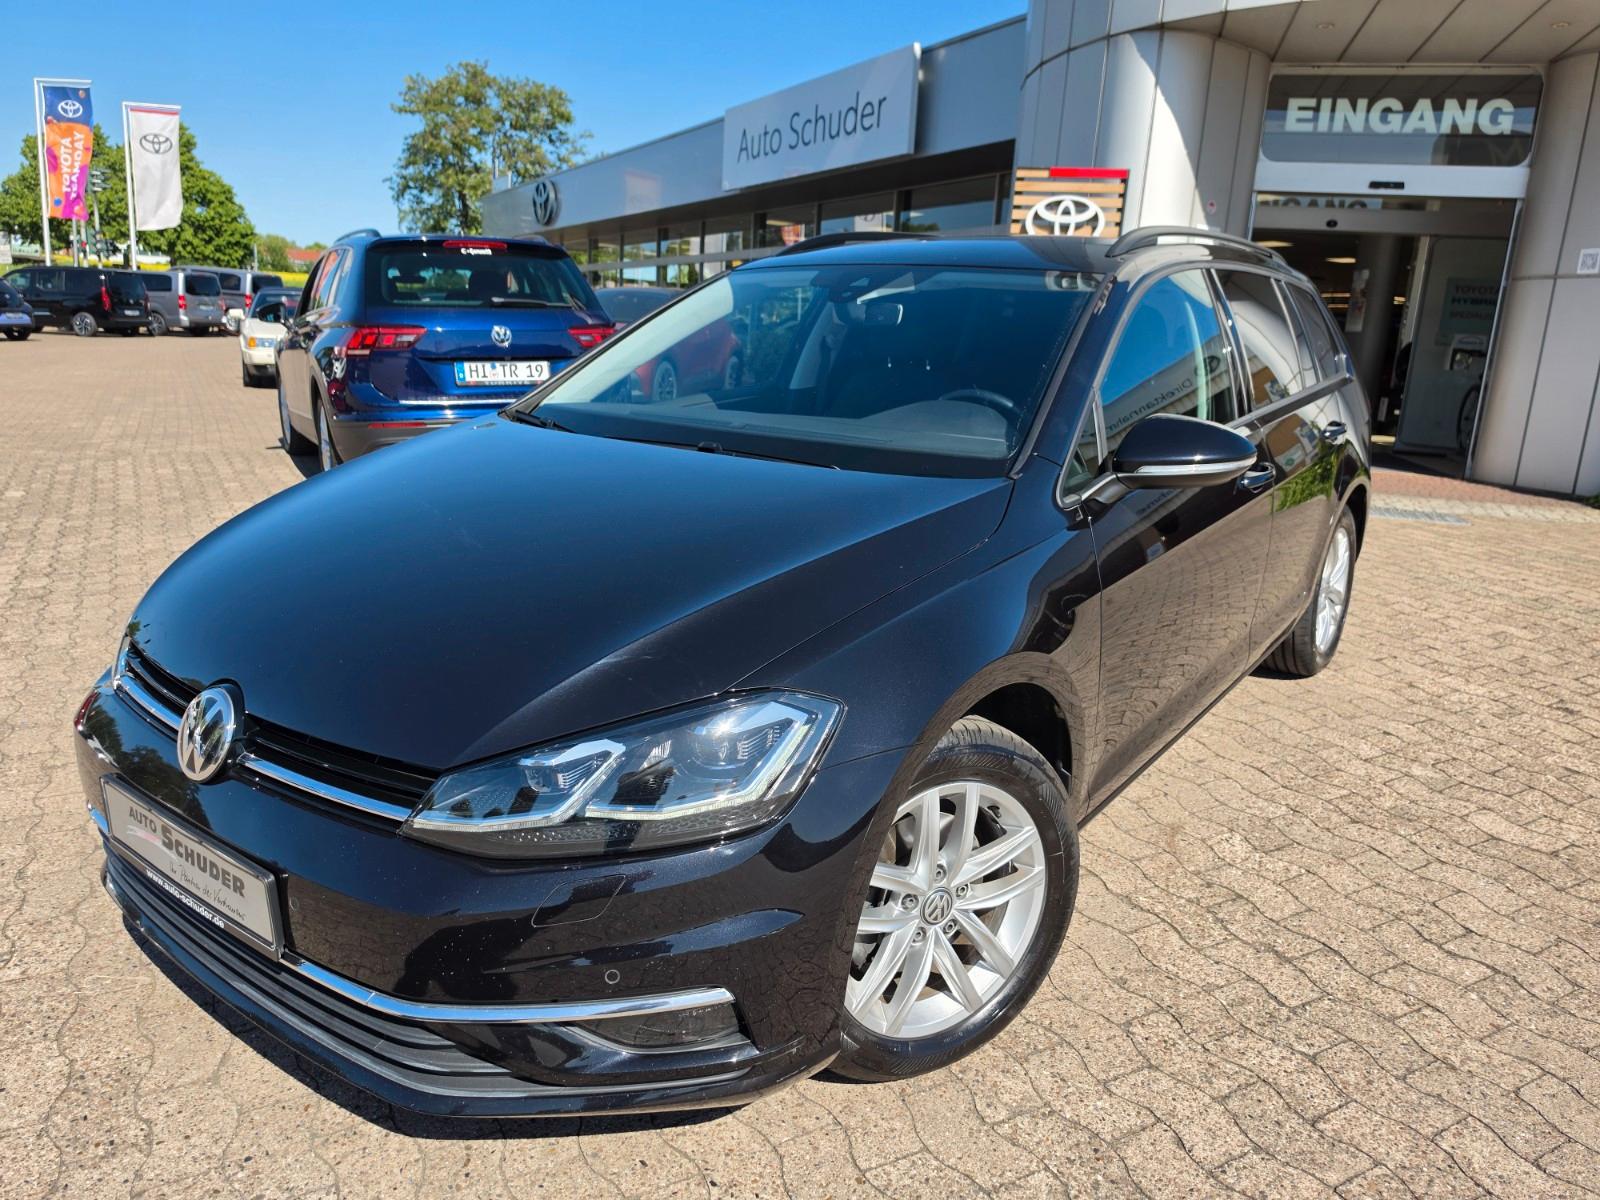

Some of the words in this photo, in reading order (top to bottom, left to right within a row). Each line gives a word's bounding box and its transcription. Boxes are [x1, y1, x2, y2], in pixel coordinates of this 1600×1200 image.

[737, 124, 783, 163] Auto
[788, 91, 888, 150] Schuder
[1284, 97, 1516, 136] EINGANG
[60, 136, 72, 193] TOYOTA
[70, 130, 85, 200] TEAMDAY
[468, 363, 489, 379] HI
[499, 363, 519, 379] TR
[526, 363, 544, 378] 19
[128, 805, 157, 833] AUTO
[160, 824, 247, 898] SCHUDER
[146, 869, 225, 929] www.auto-schuder.de
